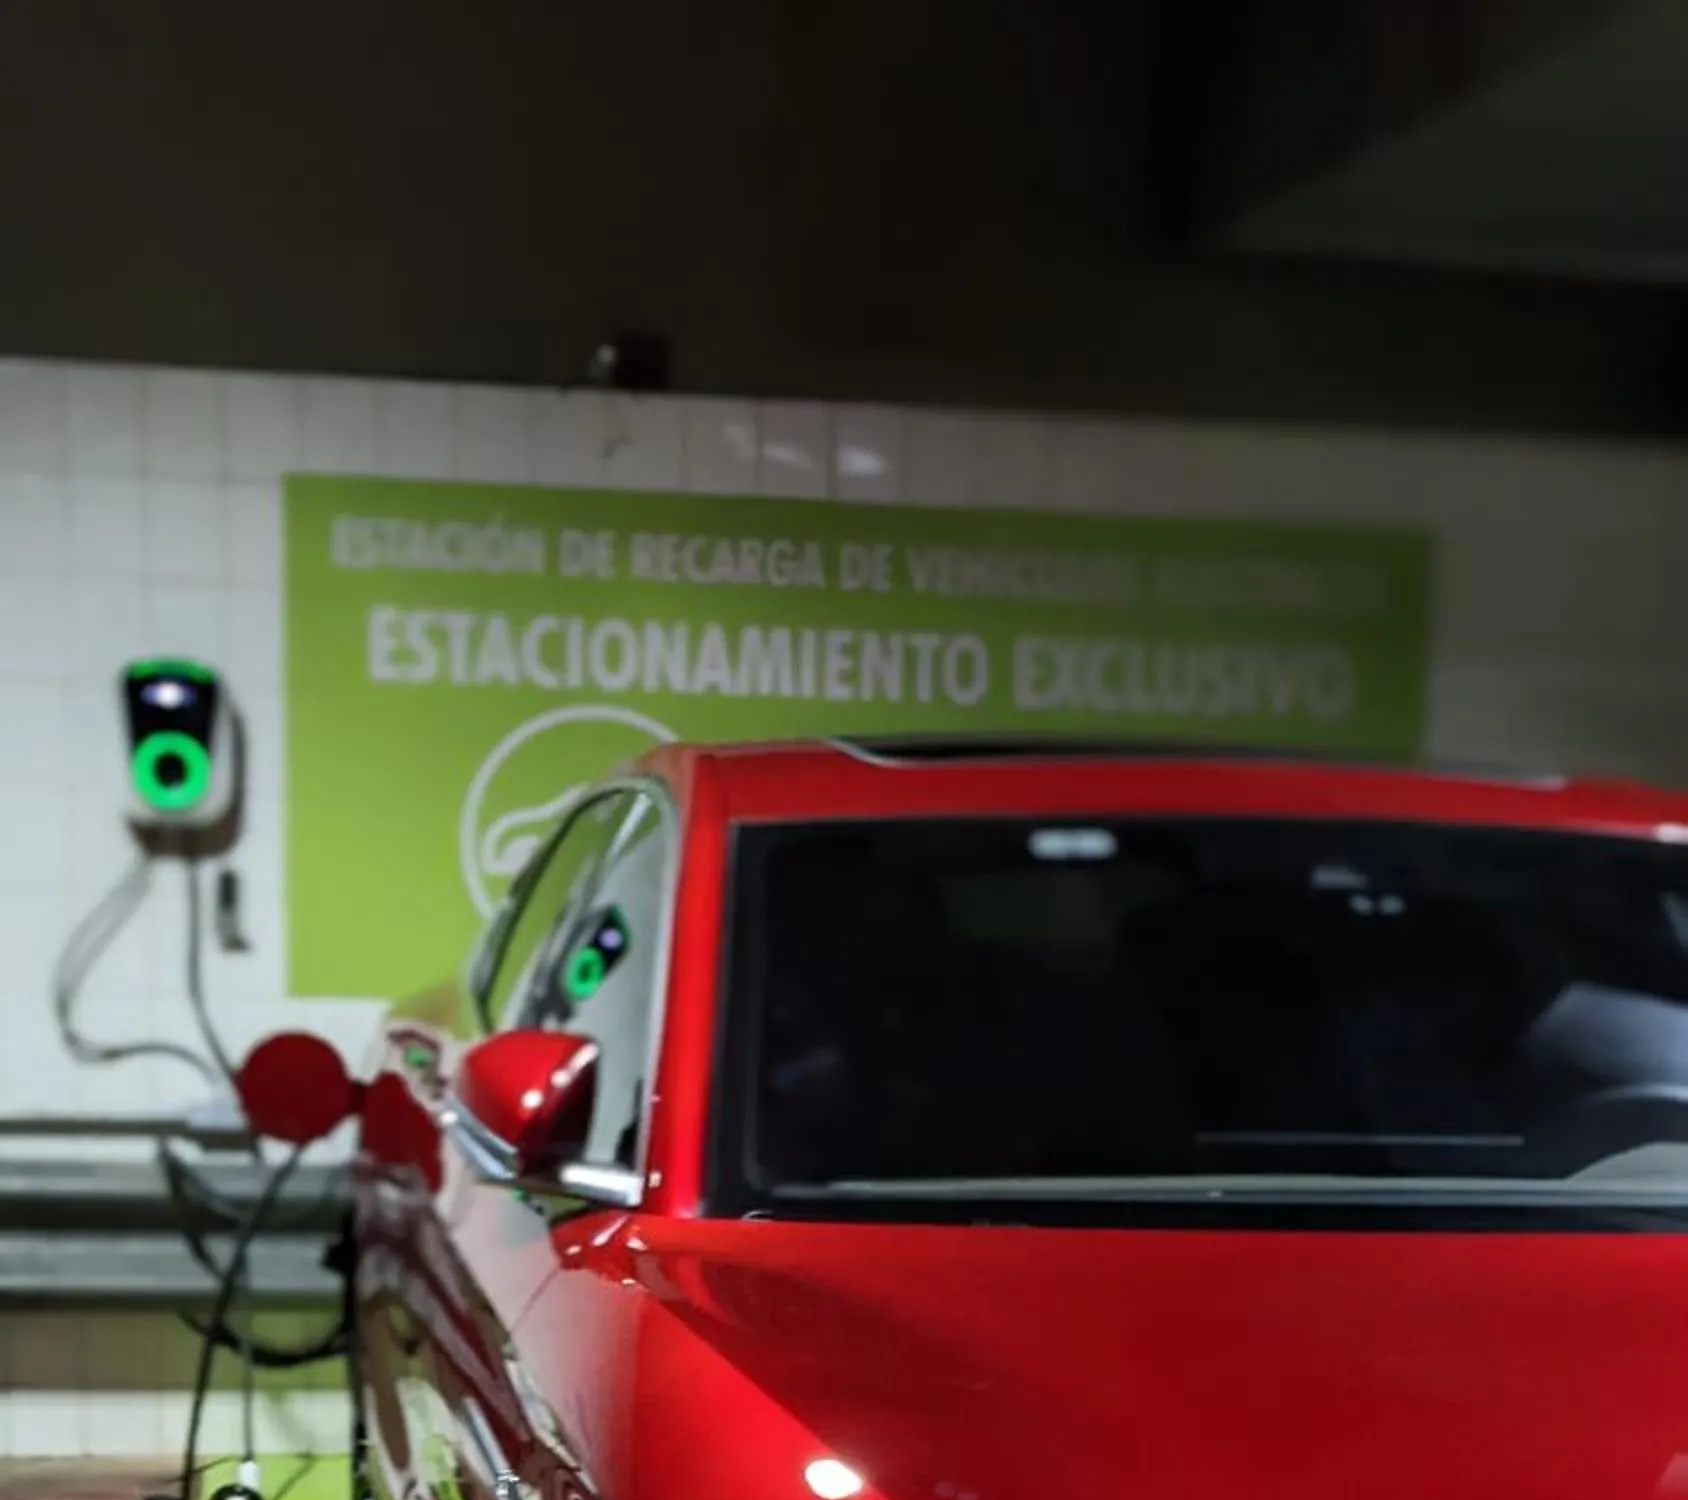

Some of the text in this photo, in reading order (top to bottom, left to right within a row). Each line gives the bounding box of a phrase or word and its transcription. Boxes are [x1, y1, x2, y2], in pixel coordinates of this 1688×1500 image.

[559, 527, 616, 580] DE
[629, 531, 825, 588] RECARGA
[840, 542, 892, 592] DE
[367, 605, 1354, 722] ESTACIONAMIENTO EXCLUSIVO
